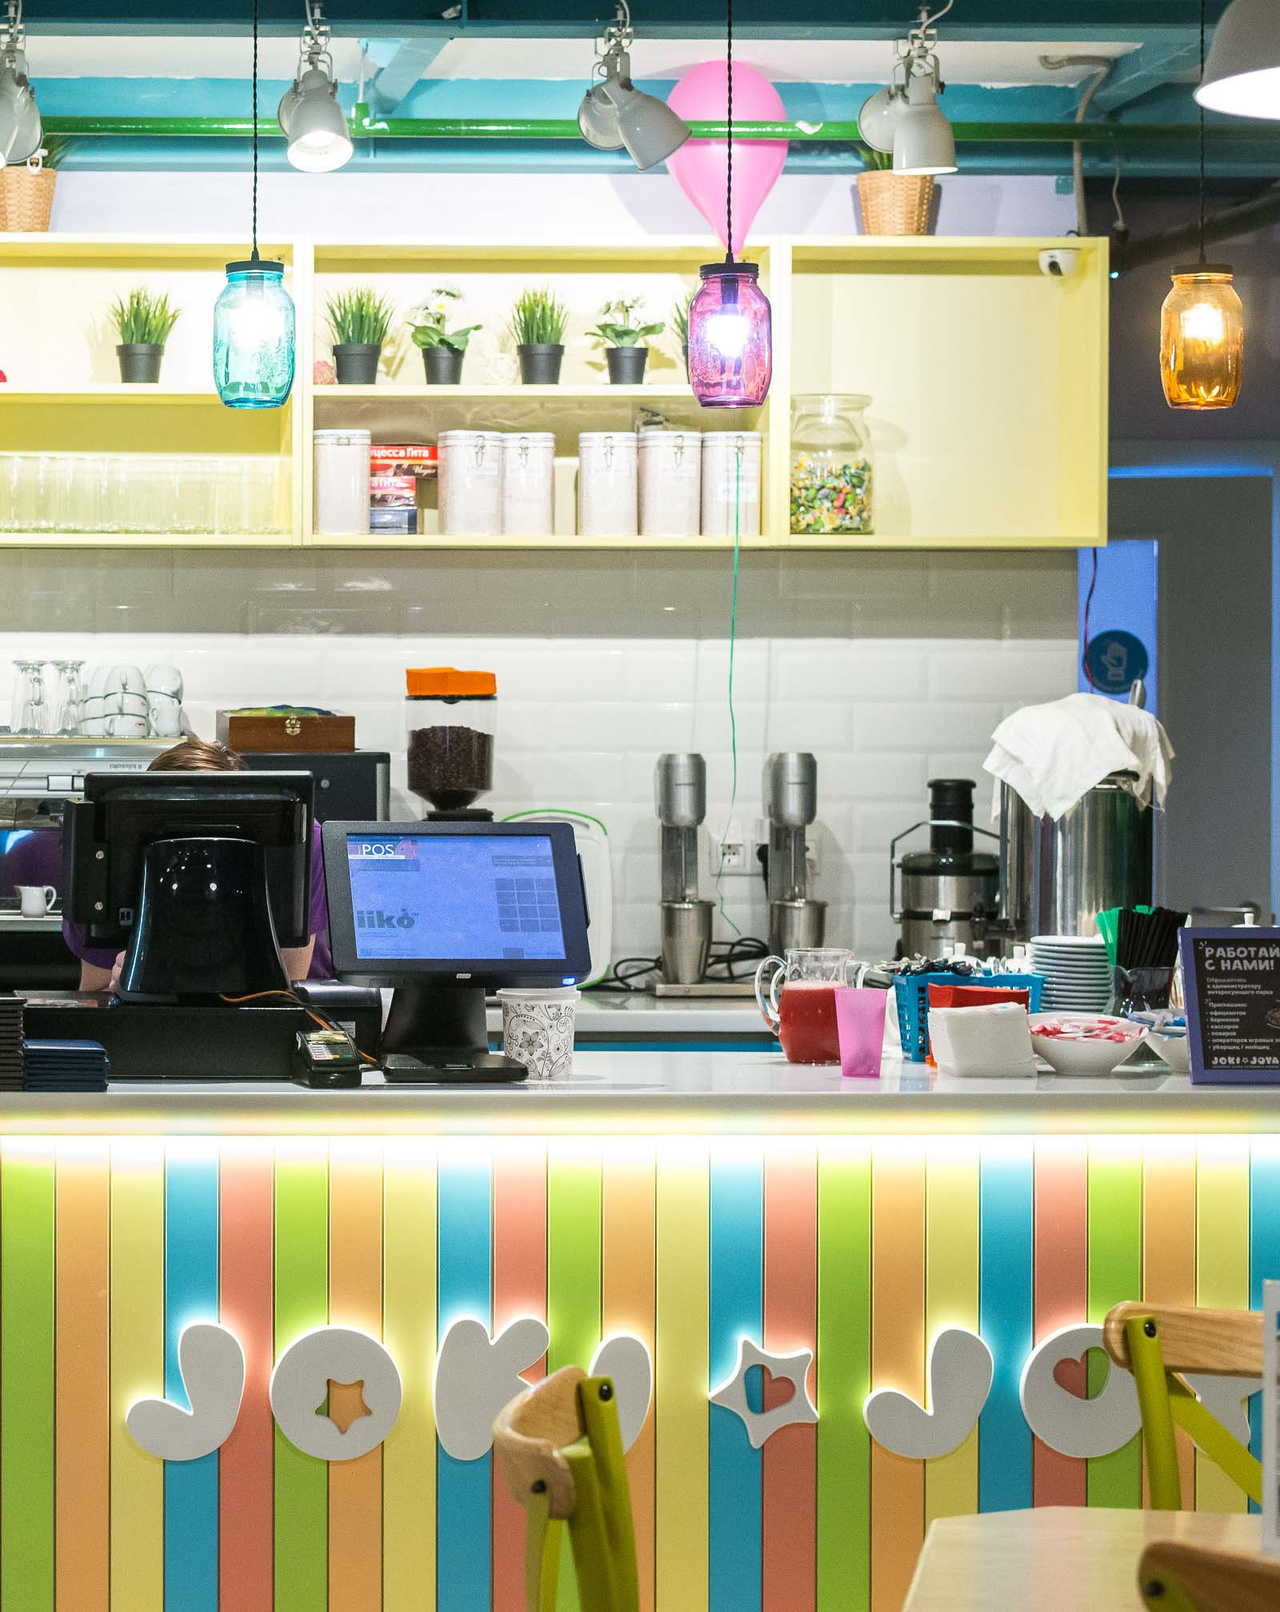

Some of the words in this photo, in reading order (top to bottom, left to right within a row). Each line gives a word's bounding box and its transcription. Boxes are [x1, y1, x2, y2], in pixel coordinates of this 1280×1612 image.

[1205, 943, 1280, 958] РАБОТАЙ
[1204, 959, 1216, 971] С
[1220, 959, 1274, 971] НАМИ!
[1211, 1056, 1241, 1065] JOKI
[1250, 1056, 1280, 1065] JOYA
